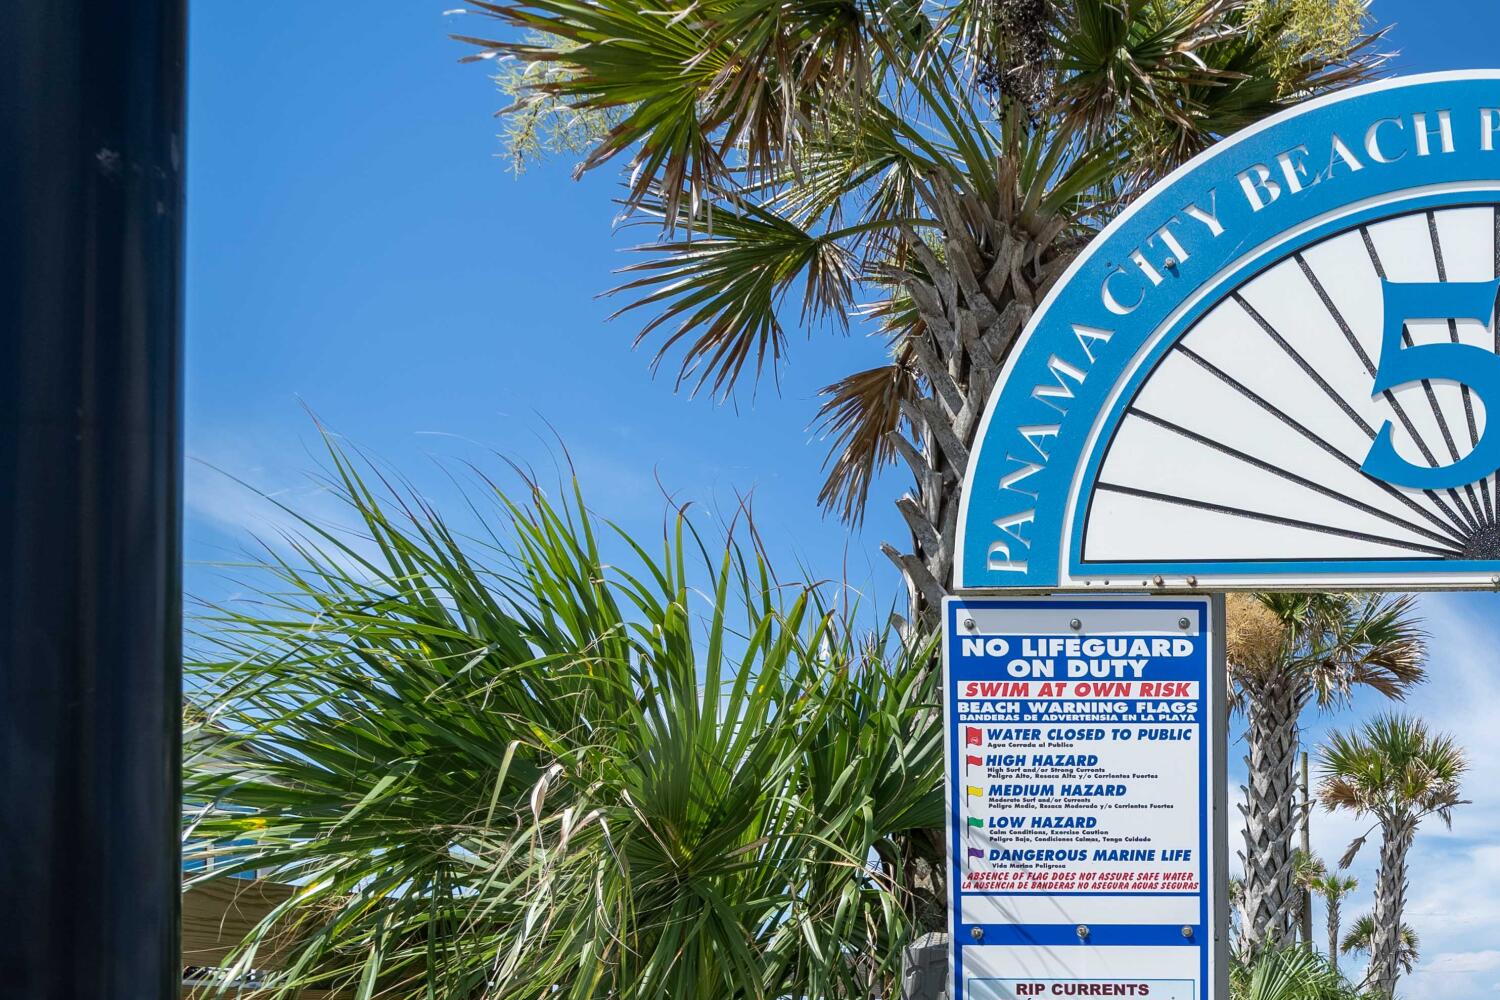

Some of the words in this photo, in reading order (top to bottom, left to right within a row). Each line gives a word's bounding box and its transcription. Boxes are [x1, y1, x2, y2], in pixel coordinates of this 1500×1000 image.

[987, 323, 1116, 576] PANAMA
[1101, 186, 1226, 315] CITY
[1234, 109, 1456, 213] BEACH
[962, 639, 1009, 656] NO
[1022, 639, 1193, 657] LIFEGUARD
[1007, 660, 1054, 677] ON
[1068, 660, 1148, 677] DUTY
[966, 682, 1029, 697] SWIM
[1038, 683, 1067, 697] AT
[1075, 683, 1131, 697] OWN
[1140, 683, 1191, 697] RISK
[958, 702, 1020, 713] BEACH
[1028, 702, 1128, 713] WARNING
[1136, 702, 1197, 713] FLAGS
[987, 729, 1041, 740] WATER
[1047, 729, 1105, 740] CLOSED
[1112, 729, 1131, 740] TO
[1138, 729, 1192, 740] PUBLIC
[986, 755, 1026, 766] HIGH
[1032, 755, 1098, 766] HAZARD
[988, 785, 1054, 796] MEDIUM
[1061, 785, 1126, 796] HAZARD
[989, 817, 1026, 828] LOW
[1031, 817, 1096, 828] HAZARD
[989, 849, 1087, 861] DANGEROUS
[1093, 850, 1155, 861] MARINE
[1161, 850, 1191, 861] LIFE
[967, 872, 1009, 880] ABSENCE
[1012, 872, 1024, 880] OF
[1027, 872, 1048, 880] FLAG
[1052, 872, 1076, 880] DOES
[1137, 872, 1159, 880] SAFE
[1163, 872, 1193, 881] WATER
[974, 881, 1014, 890] AUSENCIA
[1031, 881, 1075, 889] BANDERAS
[1016, 984, 1045, 995] RIP
[1052, 984, 1149, 996] CURRENTS
